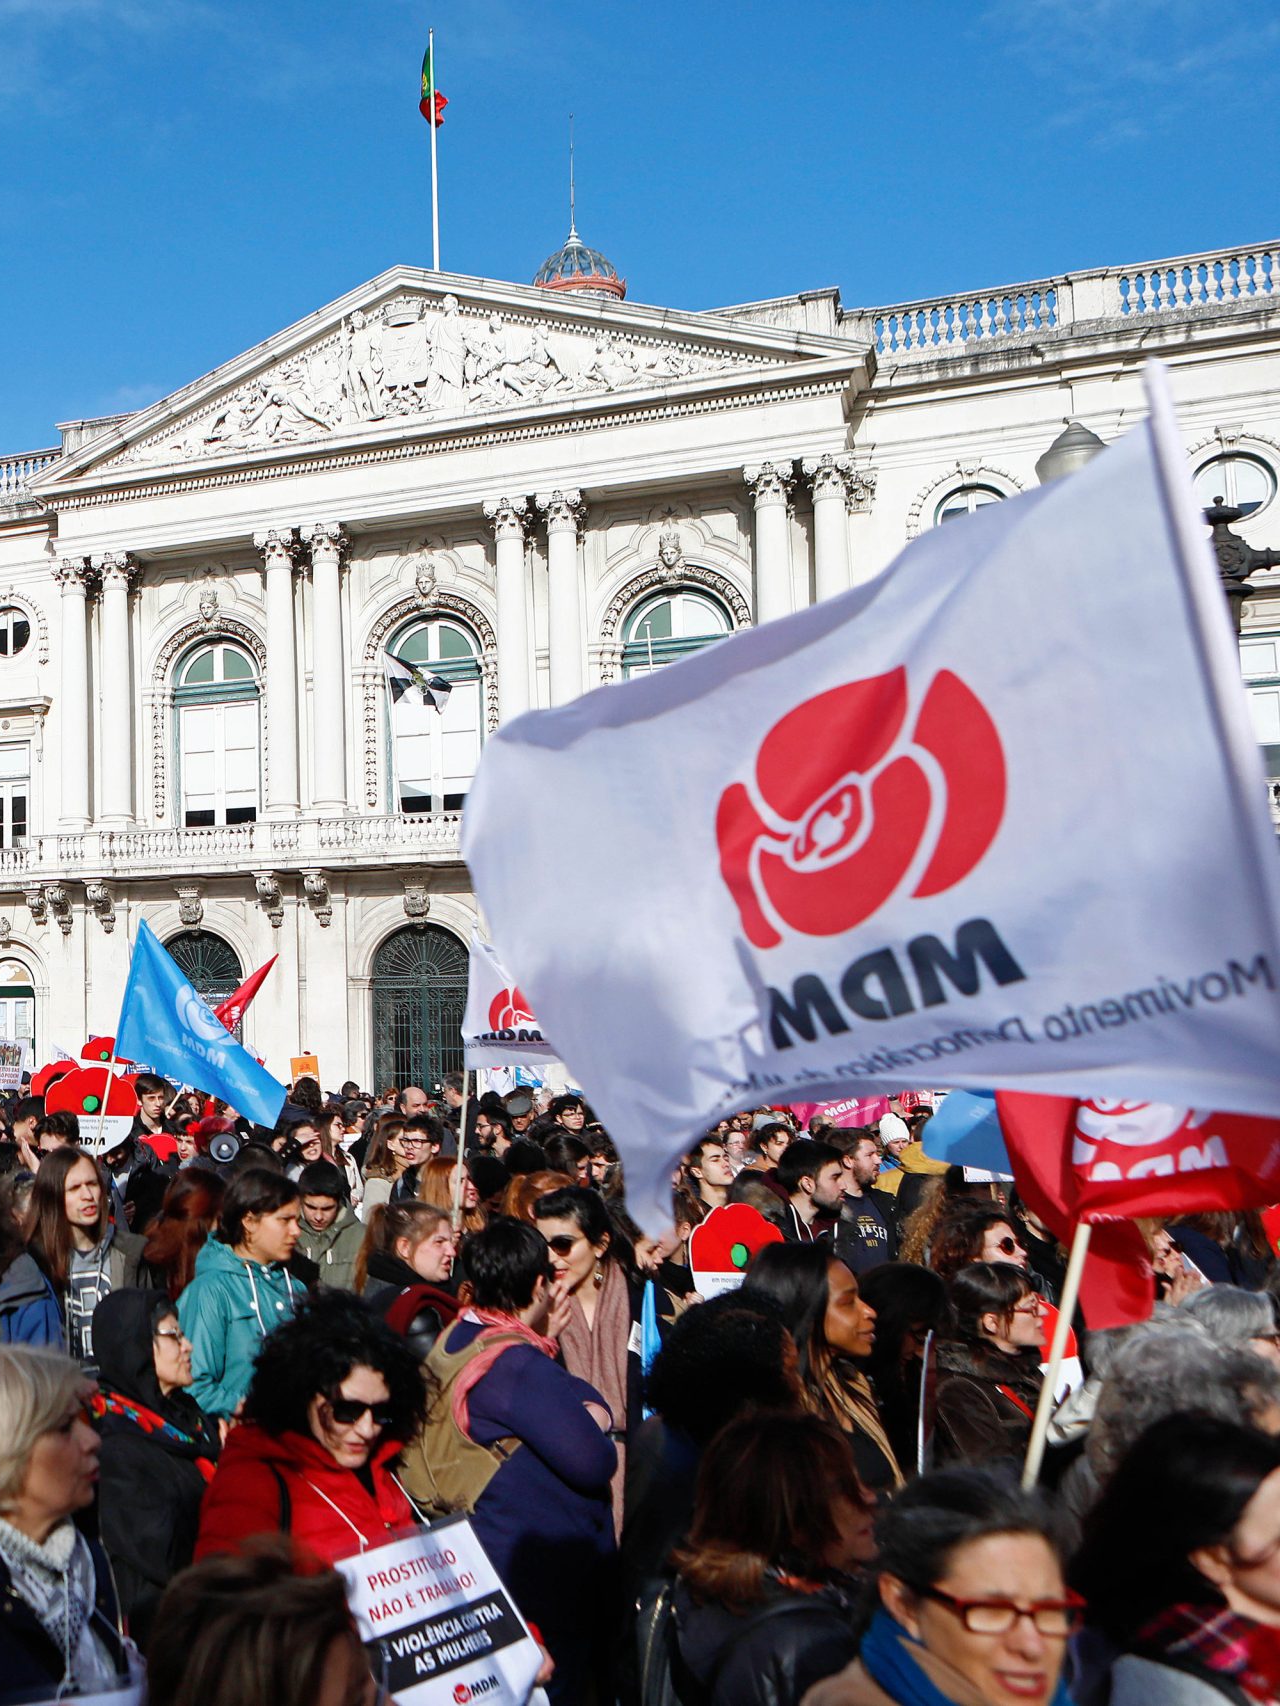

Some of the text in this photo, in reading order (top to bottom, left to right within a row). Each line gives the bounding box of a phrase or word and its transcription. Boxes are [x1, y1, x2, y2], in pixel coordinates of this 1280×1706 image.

[181, 1033, 226, 1070] MDM
[368, 1571, 477, 1624] NÃO É TRABALHO!
[391, 1620, 464, 1658] VIOLÊNCIA
[414, 1653, 436, 1674] AS
[471, 1674, 500, 1695] MDM
